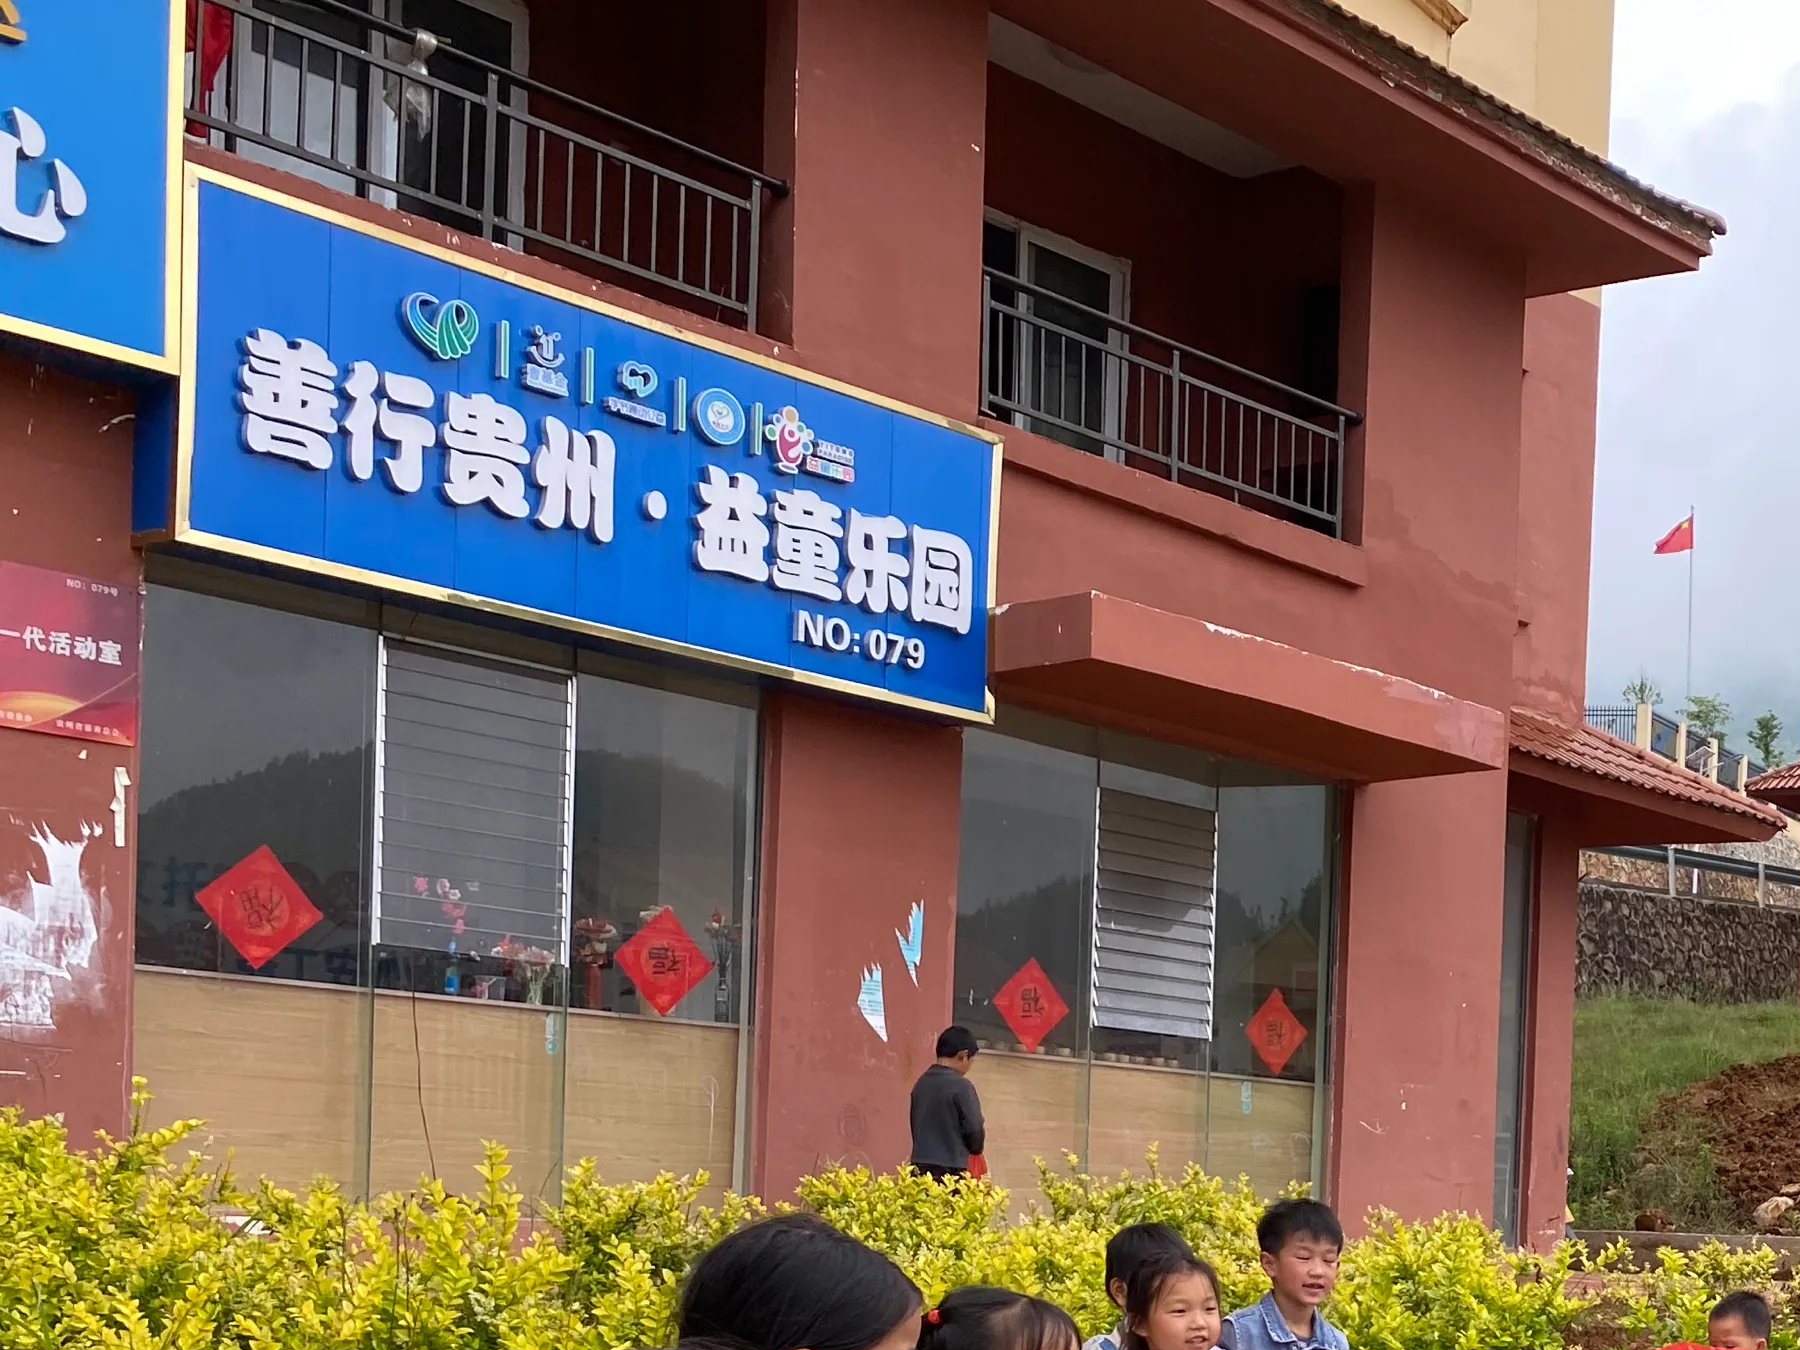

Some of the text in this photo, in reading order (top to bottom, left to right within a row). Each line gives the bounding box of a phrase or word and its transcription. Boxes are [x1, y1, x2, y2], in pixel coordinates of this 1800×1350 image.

[0, 625, 122, 666] 一代活动室
